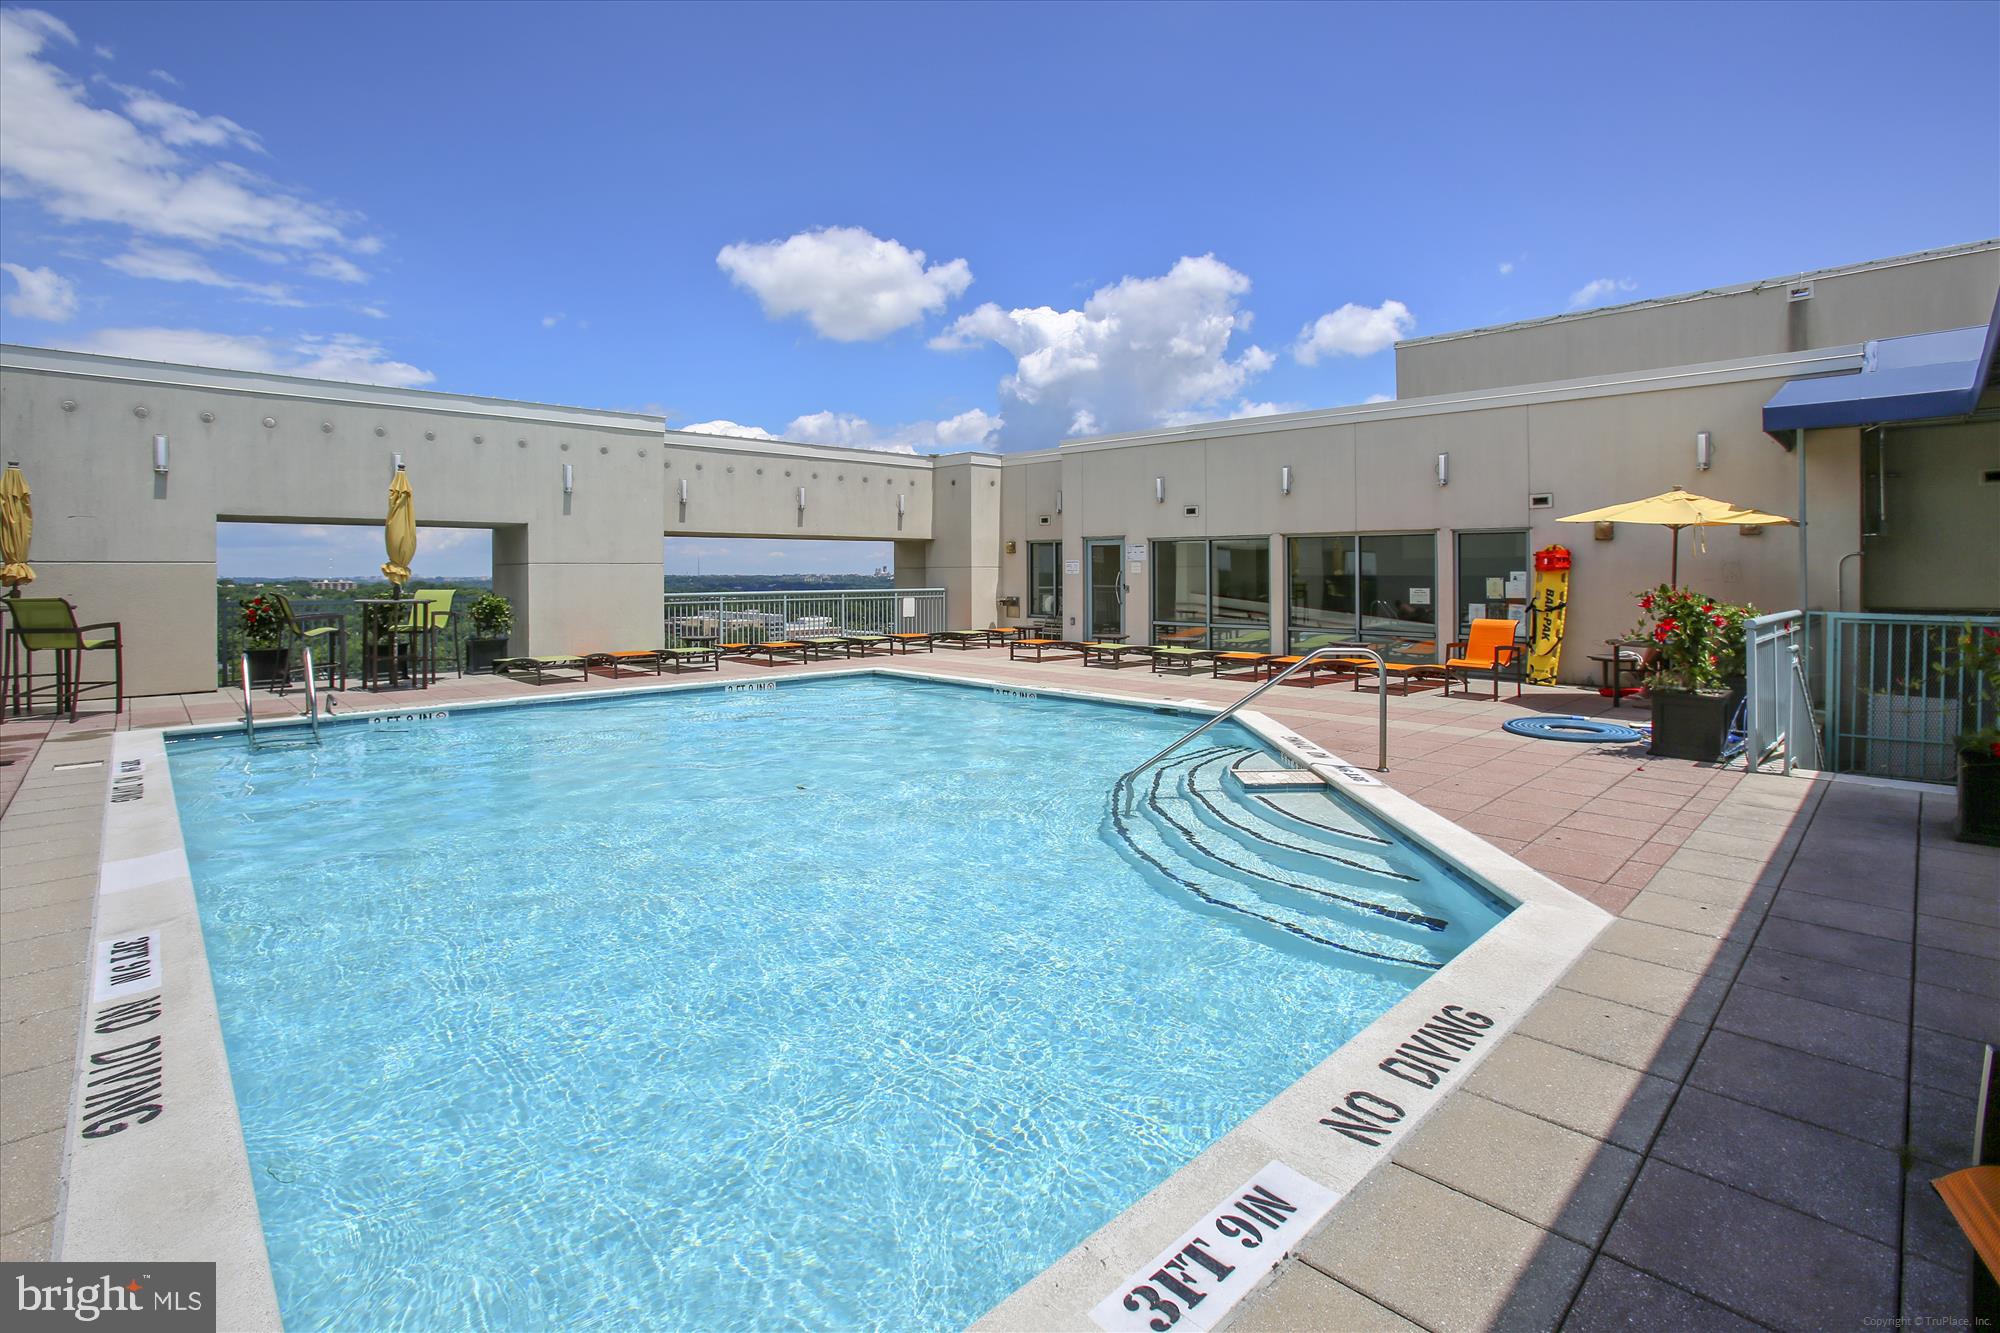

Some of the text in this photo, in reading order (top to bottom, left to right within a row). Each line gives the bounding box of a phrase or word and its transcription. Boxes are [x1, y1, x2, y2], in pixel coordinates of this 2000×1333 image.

[82, 994, 163, 1139] NO DIVING
[1319, 1004, 1495, 1147] NO DIVING
